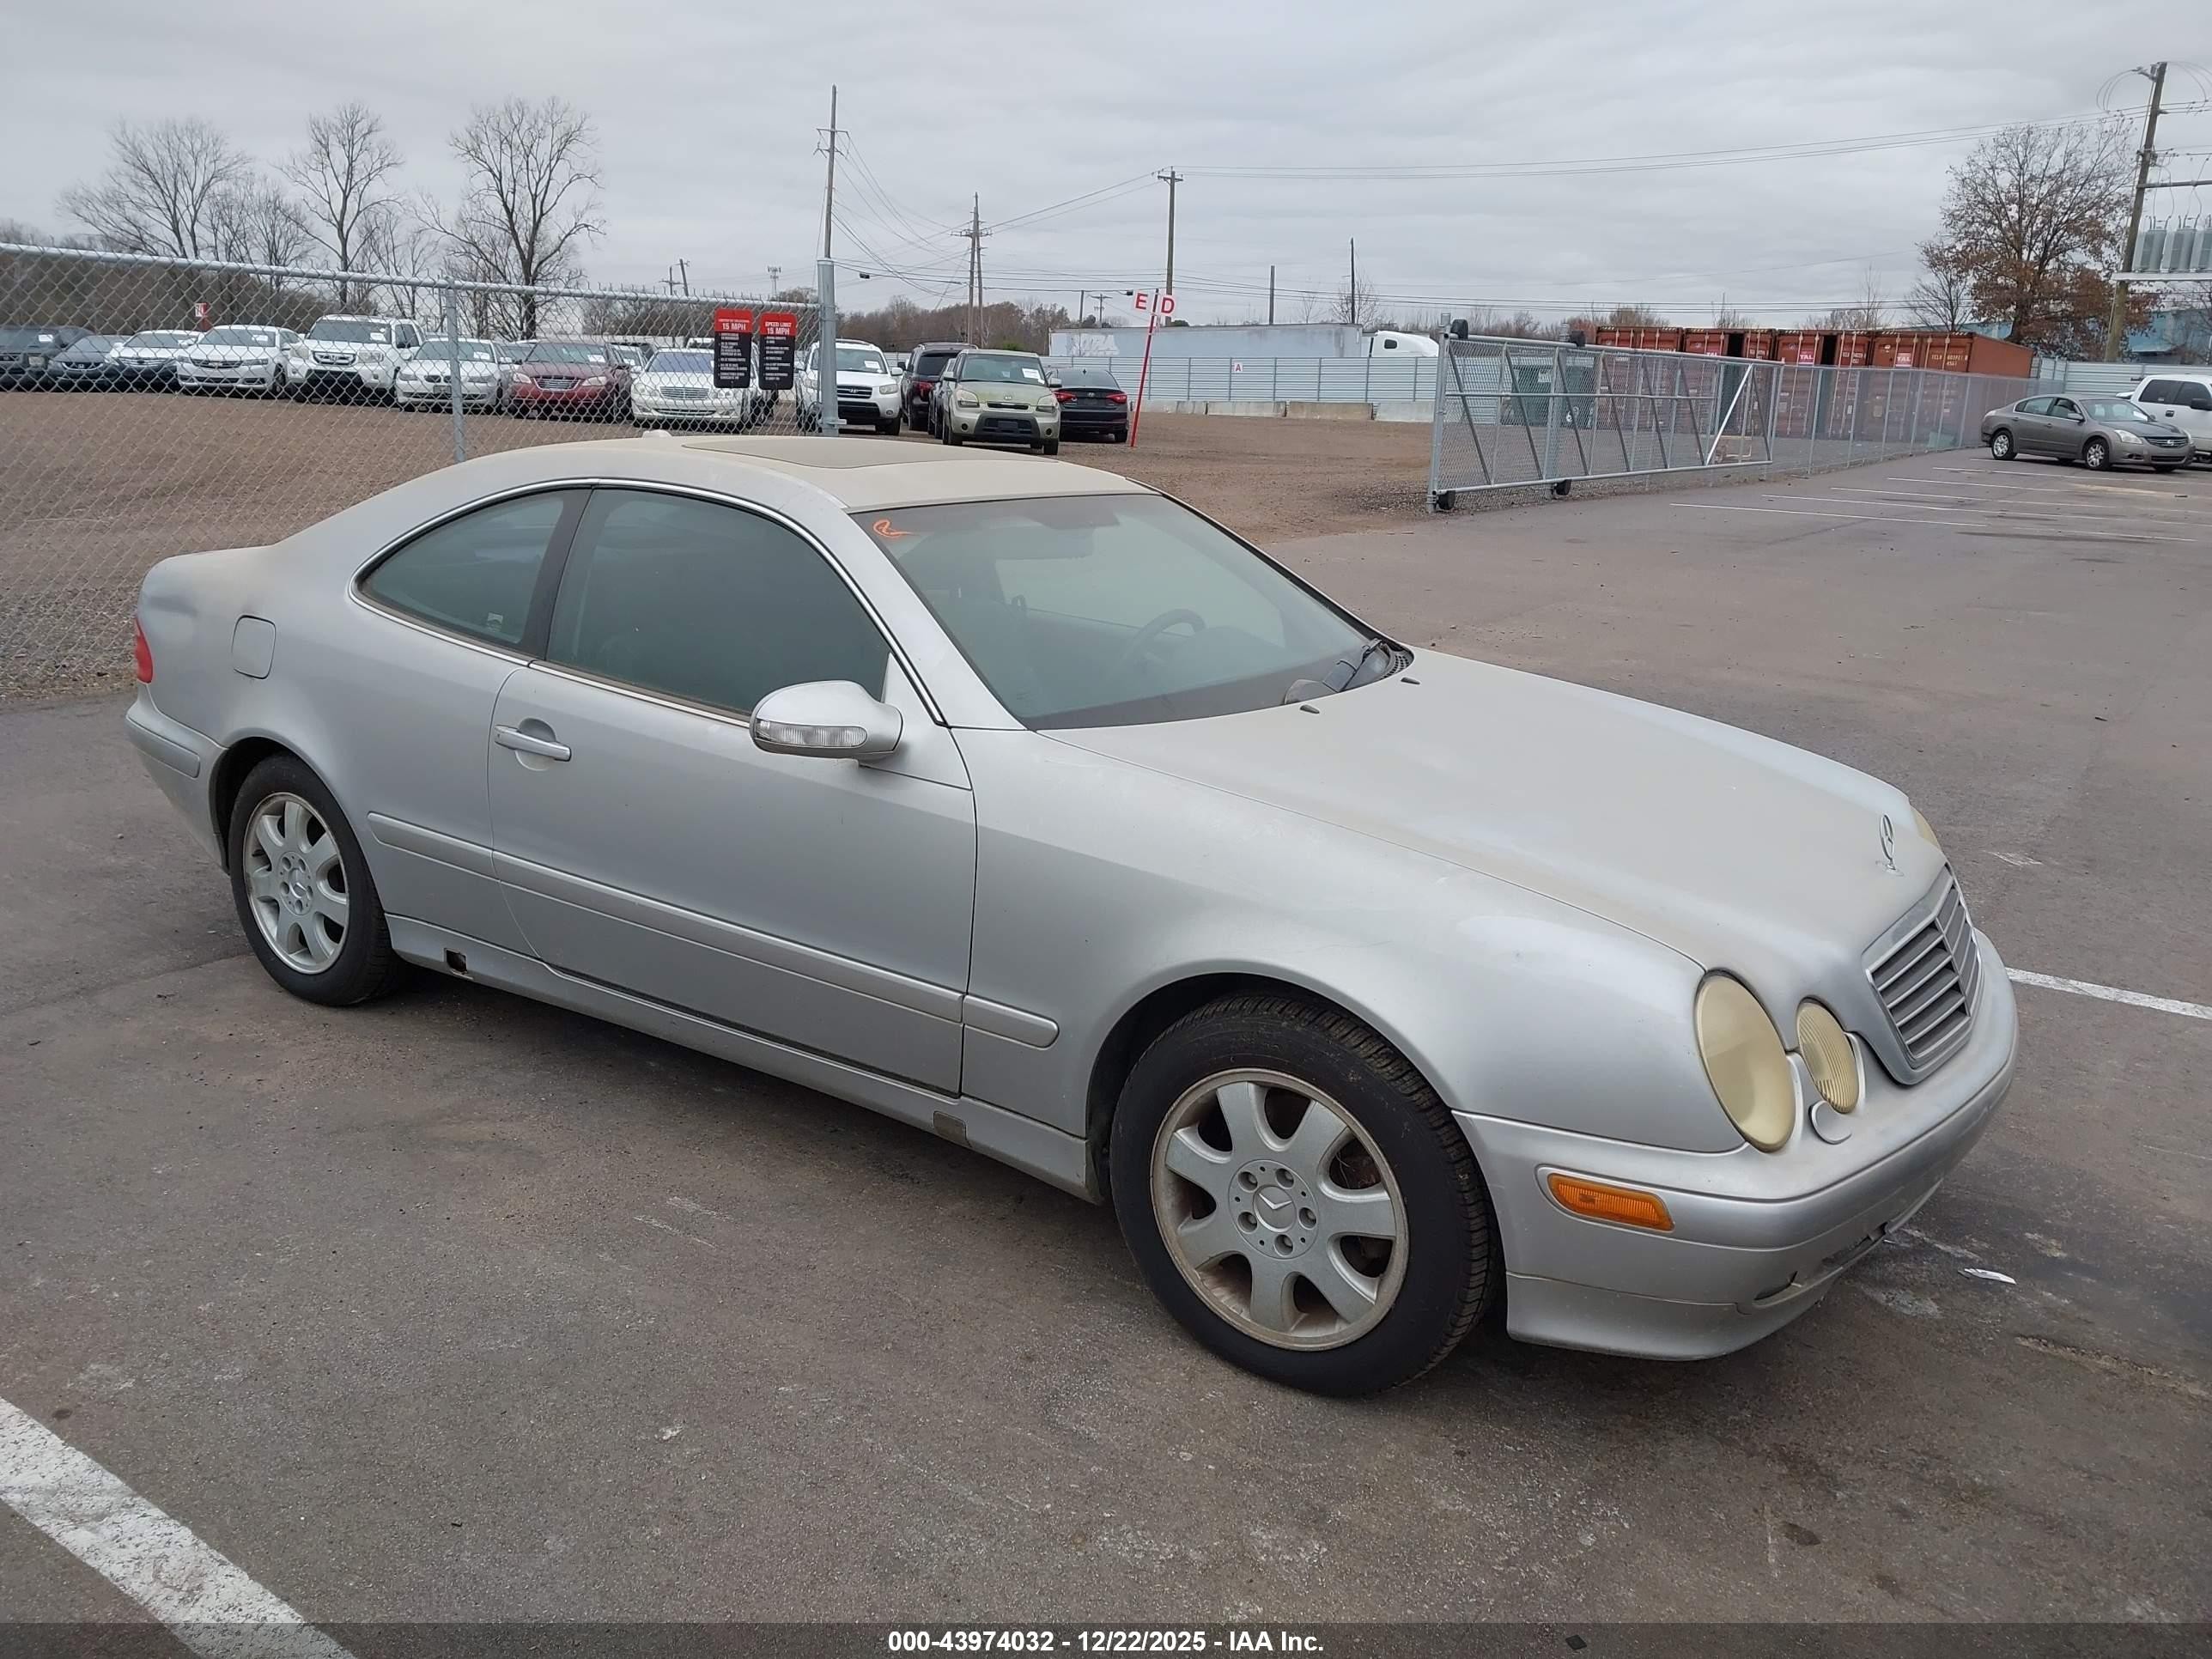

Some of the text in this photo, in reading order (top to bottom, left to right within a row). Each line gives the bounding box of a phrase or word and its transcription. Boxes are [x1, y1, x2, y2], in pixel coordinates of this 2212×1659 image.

[1135, 293, 1148, 310] E
[1161, 297, 1175, 314] D
[775, 327, 790, 336] MPH
[1235, 363, 1242, 372] A
